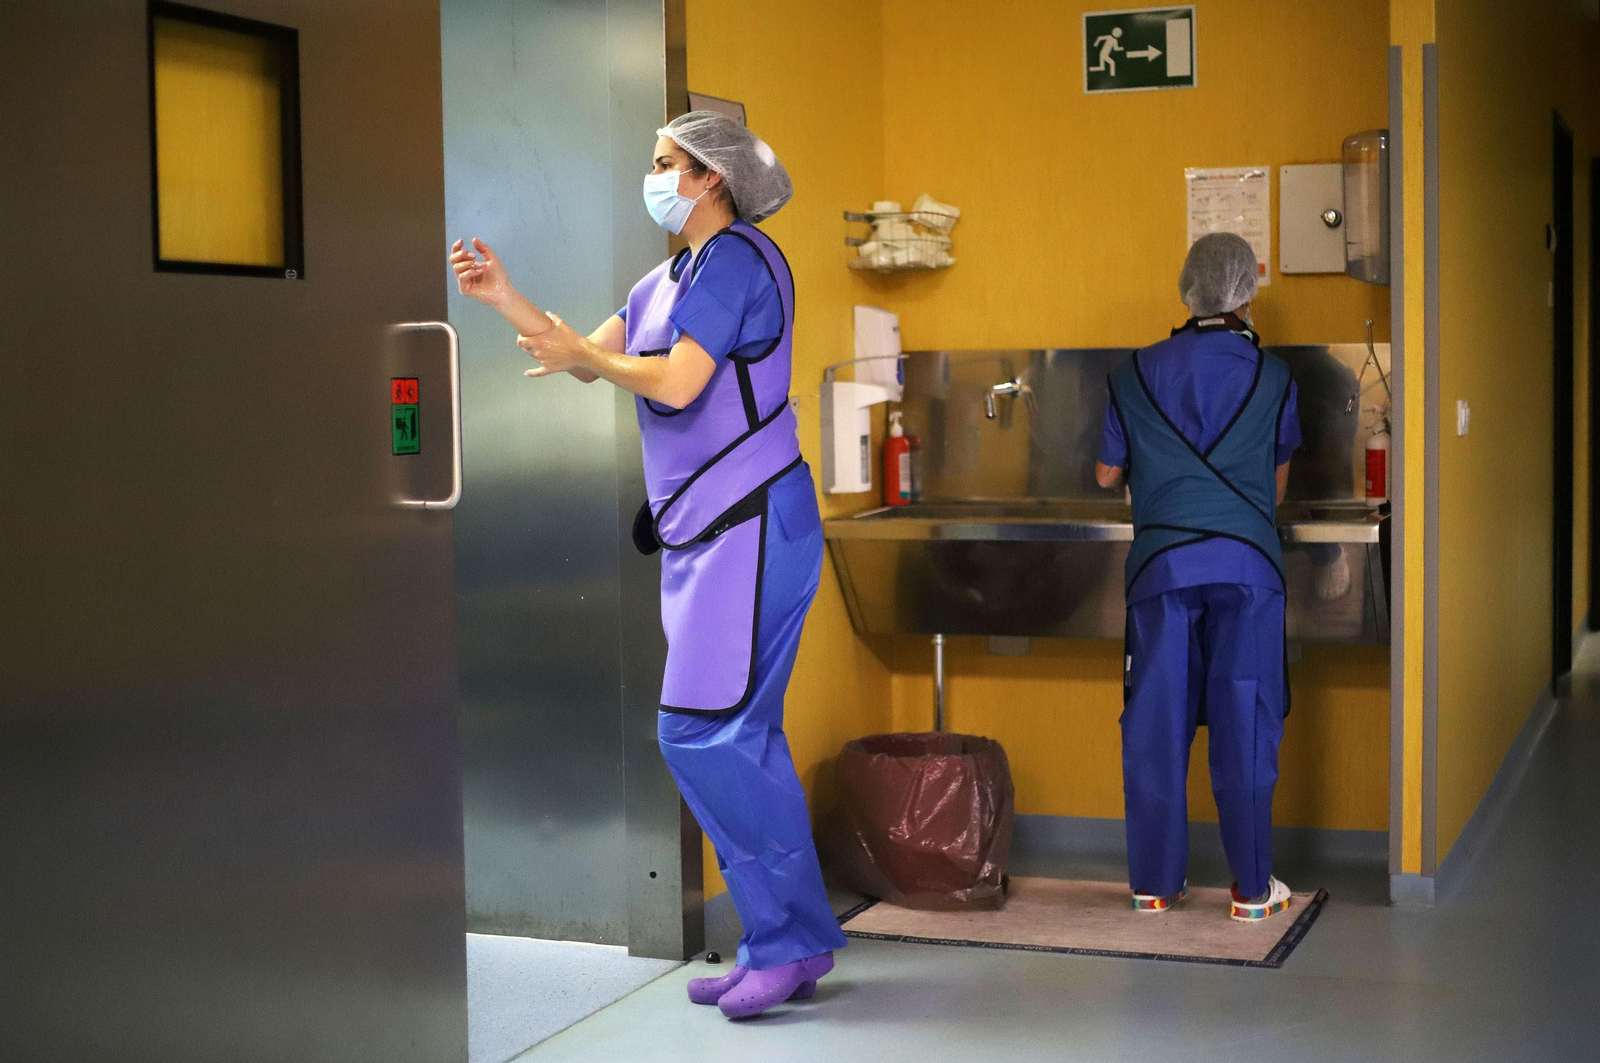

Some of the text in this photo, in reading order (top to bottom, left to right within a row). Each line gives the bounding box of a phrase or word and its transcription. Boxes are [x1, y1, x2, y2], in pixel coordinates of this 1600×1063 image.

[844, 931, 885, 939] CKWICK
[906, 937, 968, 945] QUICKWICK
[989, 943, 1053, 951] QUICKWICK
